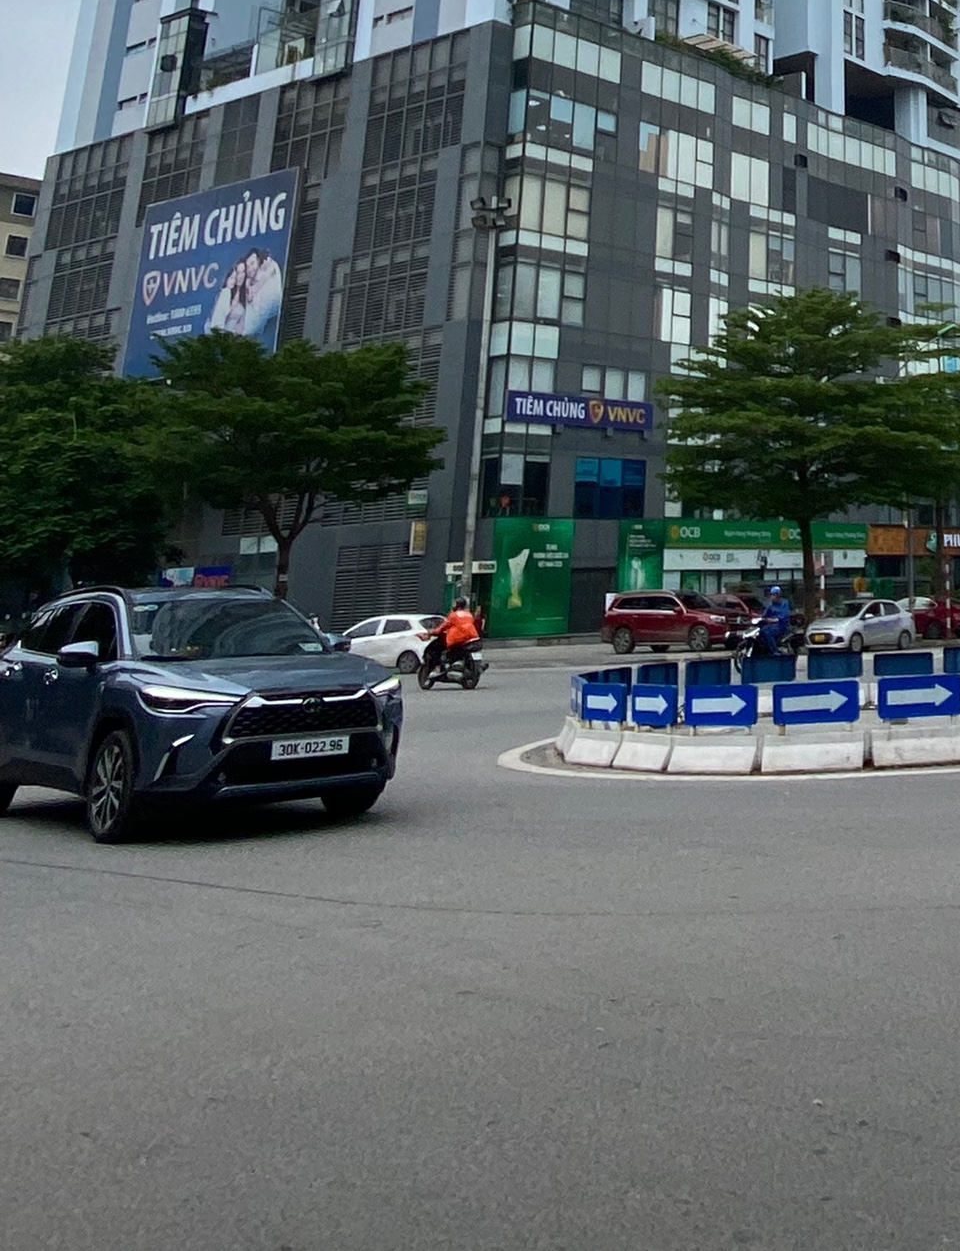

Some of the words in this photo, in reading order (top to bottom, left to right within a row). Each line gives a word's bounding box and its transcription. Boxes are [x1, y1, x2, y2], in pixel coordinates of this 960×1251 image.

[149, 212, 200, 260] TIÊM
[204, 190, 287, 246] CHỦNG
[163, 262, 219, 297] VNVC
[515, 395, 544, 416] TIÊM
[545, 396, 585, 419] CHỦNG
[607, 406, 646, 424] VNVC
[680, 526, 701, 538] OCB
[788, 528, 801, 540] OC
